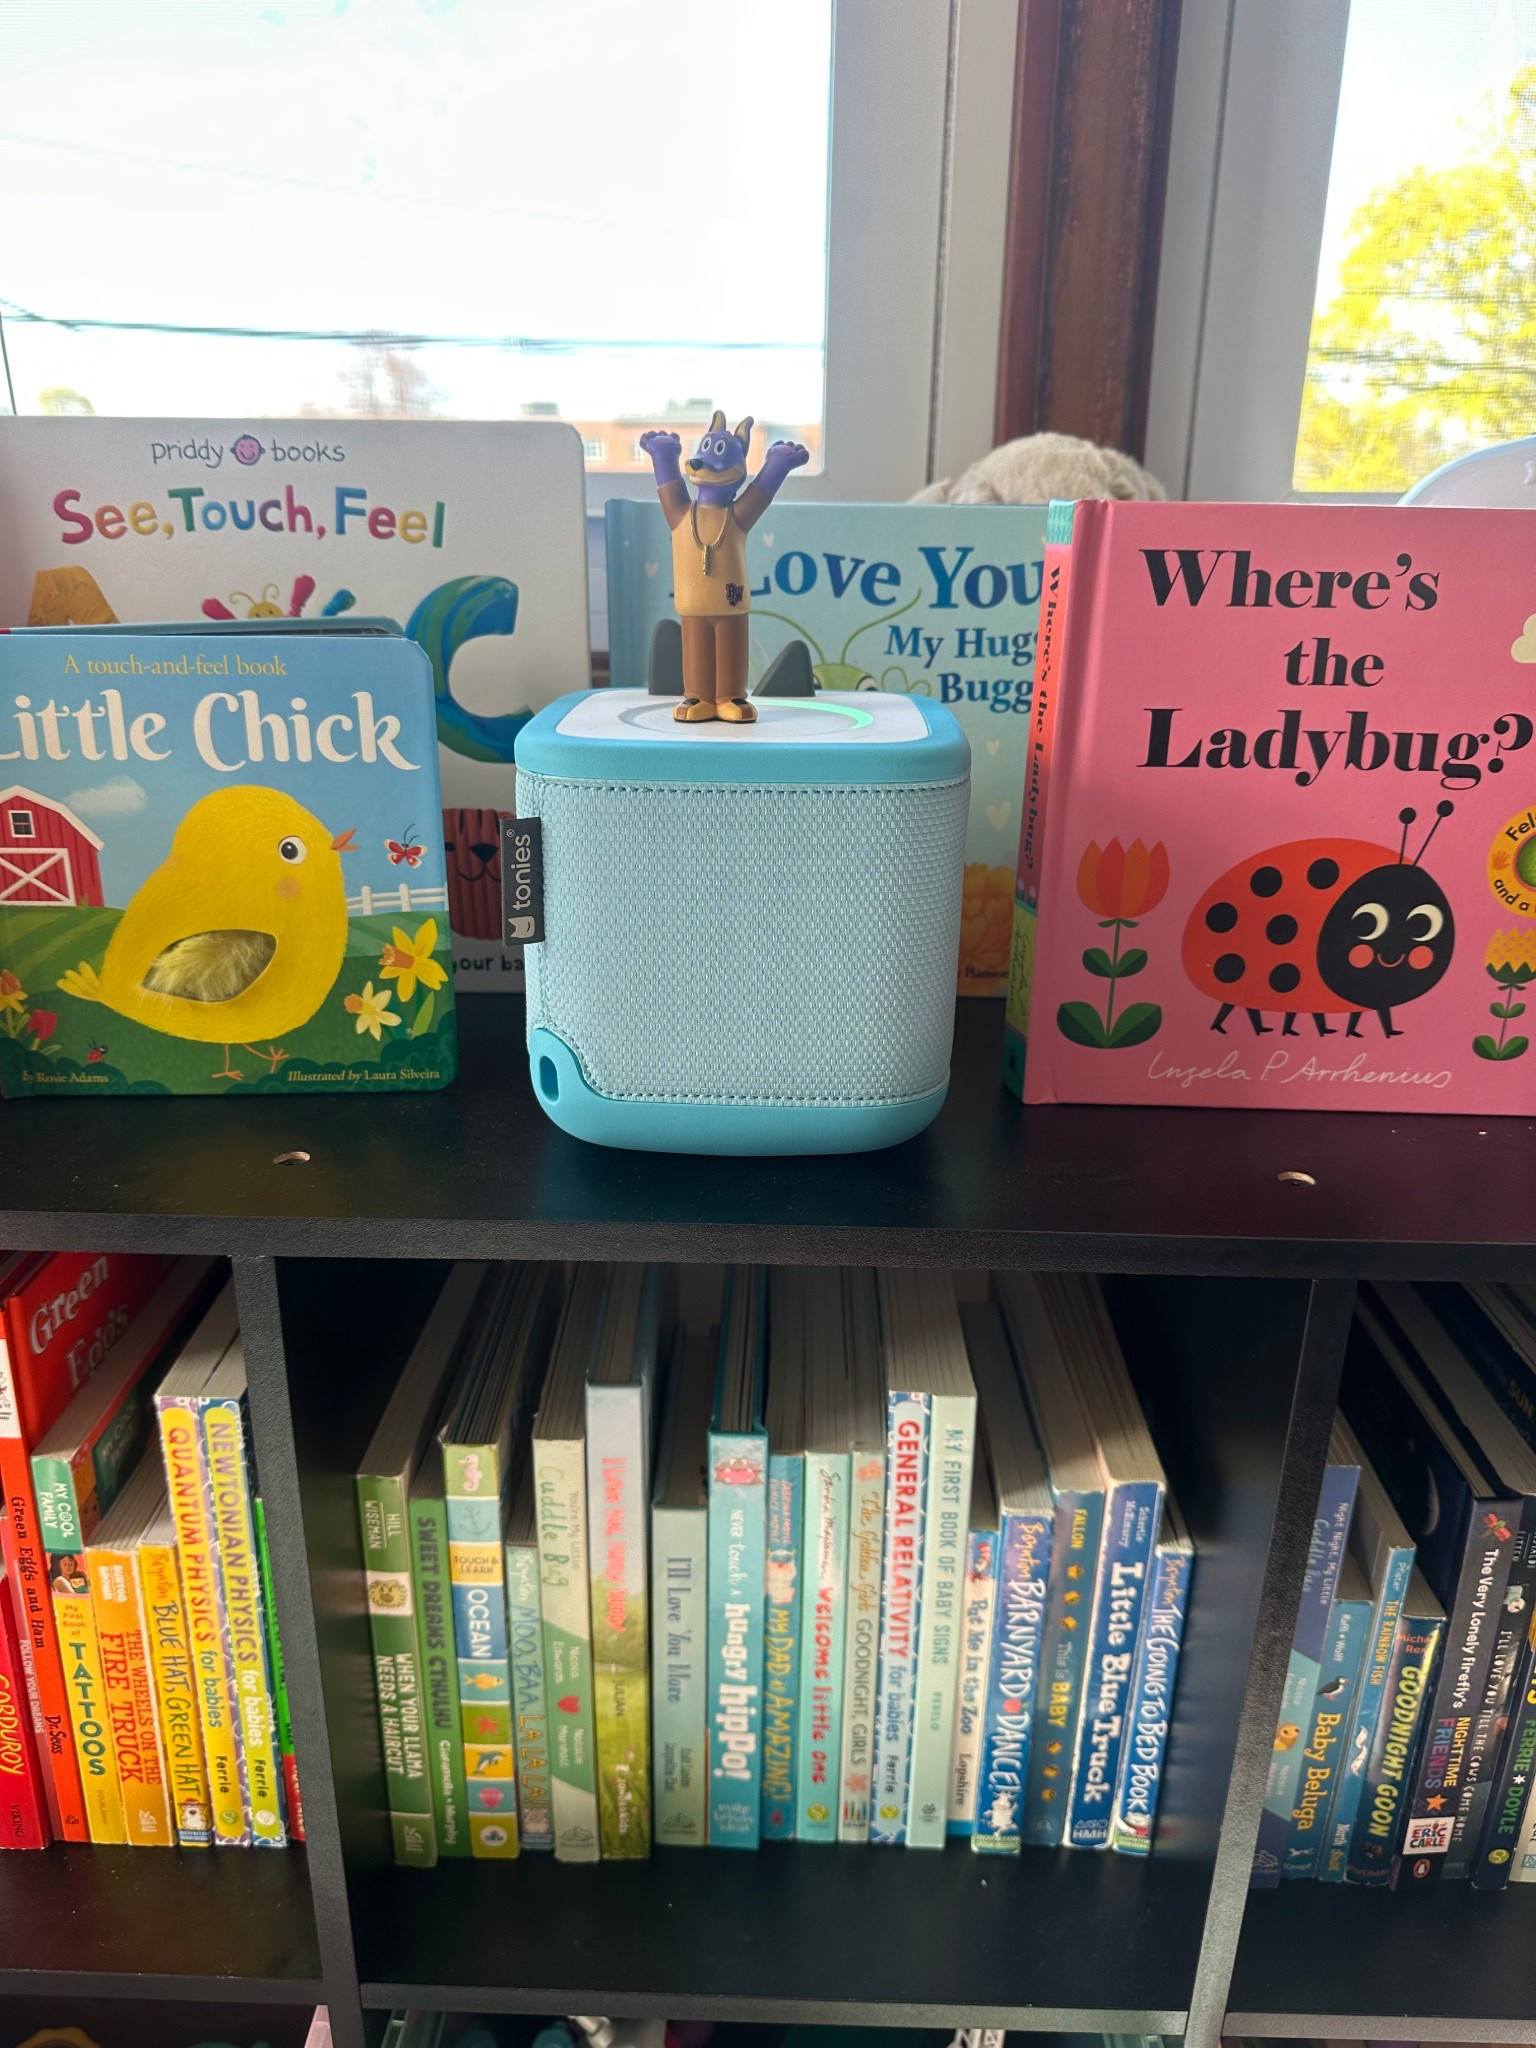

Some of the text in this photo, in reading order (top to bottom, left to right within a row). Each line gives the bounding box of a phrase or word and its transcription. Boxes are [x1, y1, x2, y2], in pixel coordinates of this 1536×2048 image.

[151, 440, 346, 468] priddy books
[53, 485, 446, 549] See, Touch, Feel
[1138, 548, 1442, 612] Where's
[64, 653, 289, 677] A touch-and-feel book
[884, 624, 1038, 669] My Hug
[1283, 636, 1386, 688] the
[938, 672, 1034, 715] Bugg
[0, 688, 422, 773] ittle Chick
[1136, 706, 1534, 792] Ladybug?
[1504, 811, 1536, 842] Fel
[1493, 878, 1530, 912] and a
[37, 1072, 68, 1083] Rosie
[70, 1072, 111, 1083] Adams
[288, 1067, 440, 1083] Illustrated by Laura Silveira
[1148, 1050, 1252, 1088] Ingela
[1280, 1052, 1453, 1089] Arrhenius
[30, 1255, 110, 1356] Green
[40, 1491, 59, 1529] FAMILY
[54, 1482, 75, 1538] MY COOL
[365, 1500, 383, 1549] WISEMAN
[386, 1513, 402, 1537] HILL
[538, 1465, 571, 1587] Cuddle Bug
[730, 1509, 745, 1538] NEVER
[1070, 1508, 1089, 1550] FALLON
[728, 1541, 749, 1586] touch
[931, 1428, 965, 1666] MY FIRST BOOK OF BABY SIGNS
[1013, 1520, 1046, 1579] Boynton
[11, 1496, 45, 1649] Green Eggs and Ham
[168, 1426, 225, 1728] QUANTUM PHYSICS for babies
[209, 1423, 265, 1747] NEWTONIAN PHYSICS for babies
[153, 1600, 186, 1650] BLUE
[417, 1516, 454, 1731] SWEET DREAMS CTHULHU
[468, 1588, 494, 1659] OCEAN
[666, 1586, 692, 1622] Love
[885, 1419, 922, 1795] GENERAL RELATIVITY for babies Ferrie
[1150, 1603, 1184, 1641] THE
[511, 1604, 541, 1658] MOO,
[666, 1628, 692, 1657] You
[721, 1602, 752, 1681] hungry
[967, 1630, 987, 1651] Me
[997, 1577, 1048, 1699] BARNYARD
[1370, 1600, 1400, 1686] THE RAINBOW FISH
[1452, 1548, 1500, 1710] The Very Lonely Firefly's
[160, 1655, 191, 1693] HAT,
[764, 1635, 795, 1676] DAD
[965, 1656, 983, 1677] in
[1144, 1637, 1181, 1697] GOING
[1489, 1654, 1508, 1680] LOVE
[126, 1629, 161, 1785] THE WHEELS ON THE
[515, 1660, 542, 1712] BAA,
[612, 1679, 626, 1717] JULIAN
[667, 1663, 692, 1704] More
[850, 1618, 874, 1767] GOODNIGHT, GIRLS
[962, 1677, 980, 1702] the
[1048, 1681, 1072, 1728] BABY
[1083, 1561, 1145, 1804] Little Blue Truck
[1484, 1683, 1500, 1704] YOU
[69, 1642, 107, 1776] TATTOOS
[101, 1631, 144, 1784] FIRE TRUCK
[166, 1697, 195, 1759] GREEN
[376, 1655, 405, 1777] NEEDS A HAIRCUT
[396, 1652, 424, 1780] WHEN YOUR LLAMA
[518, 1713, 544, 1743] LA
[713, 1682, 759, 1782] hippo!
[811, 1685, 833, 1742] little
[960, 1704, 978, 1735] Zoo
[520, 1746, 546, 1772] LA
[762, 1691, 796, 1801] AMAZING!
[1136, 1719, 1169, 1762] BED
[1368, 1665, 1422, 1838] GOODNIGHT GOON
[1424, 1717, 1456, 1789] FRIENDS
[1442, 1716, 1472, 1788] NIGHTTIME
[1473, 1733, 1488, 1751] THE
[174, 1763, 202, 1797] HAT
[216, 1755, 232, 1794] Ferrie
[254, 1758, 270, 1798] Ferrie
[810, 1749, 828, 1785] one
[955, 1752, 973, 1807] Lopshire
[1126, 1762, 1160, 1814] BOOK
[1291, 1711, 1342, 1831] Baby Beluga
[1465, 1755, 1483, 1783] COWS
[1458, 1785, 1476, 1812] COME
[1498, 1786, 1526, 1835] DOYLE
[1072, 1829, 1108, 1841] HMH
[1410, 1837, 1446, 1849] CARLE
[1411, 1827, 1448, 1839] ERIC
[1451, 1815, 1468, 1842] HOME
